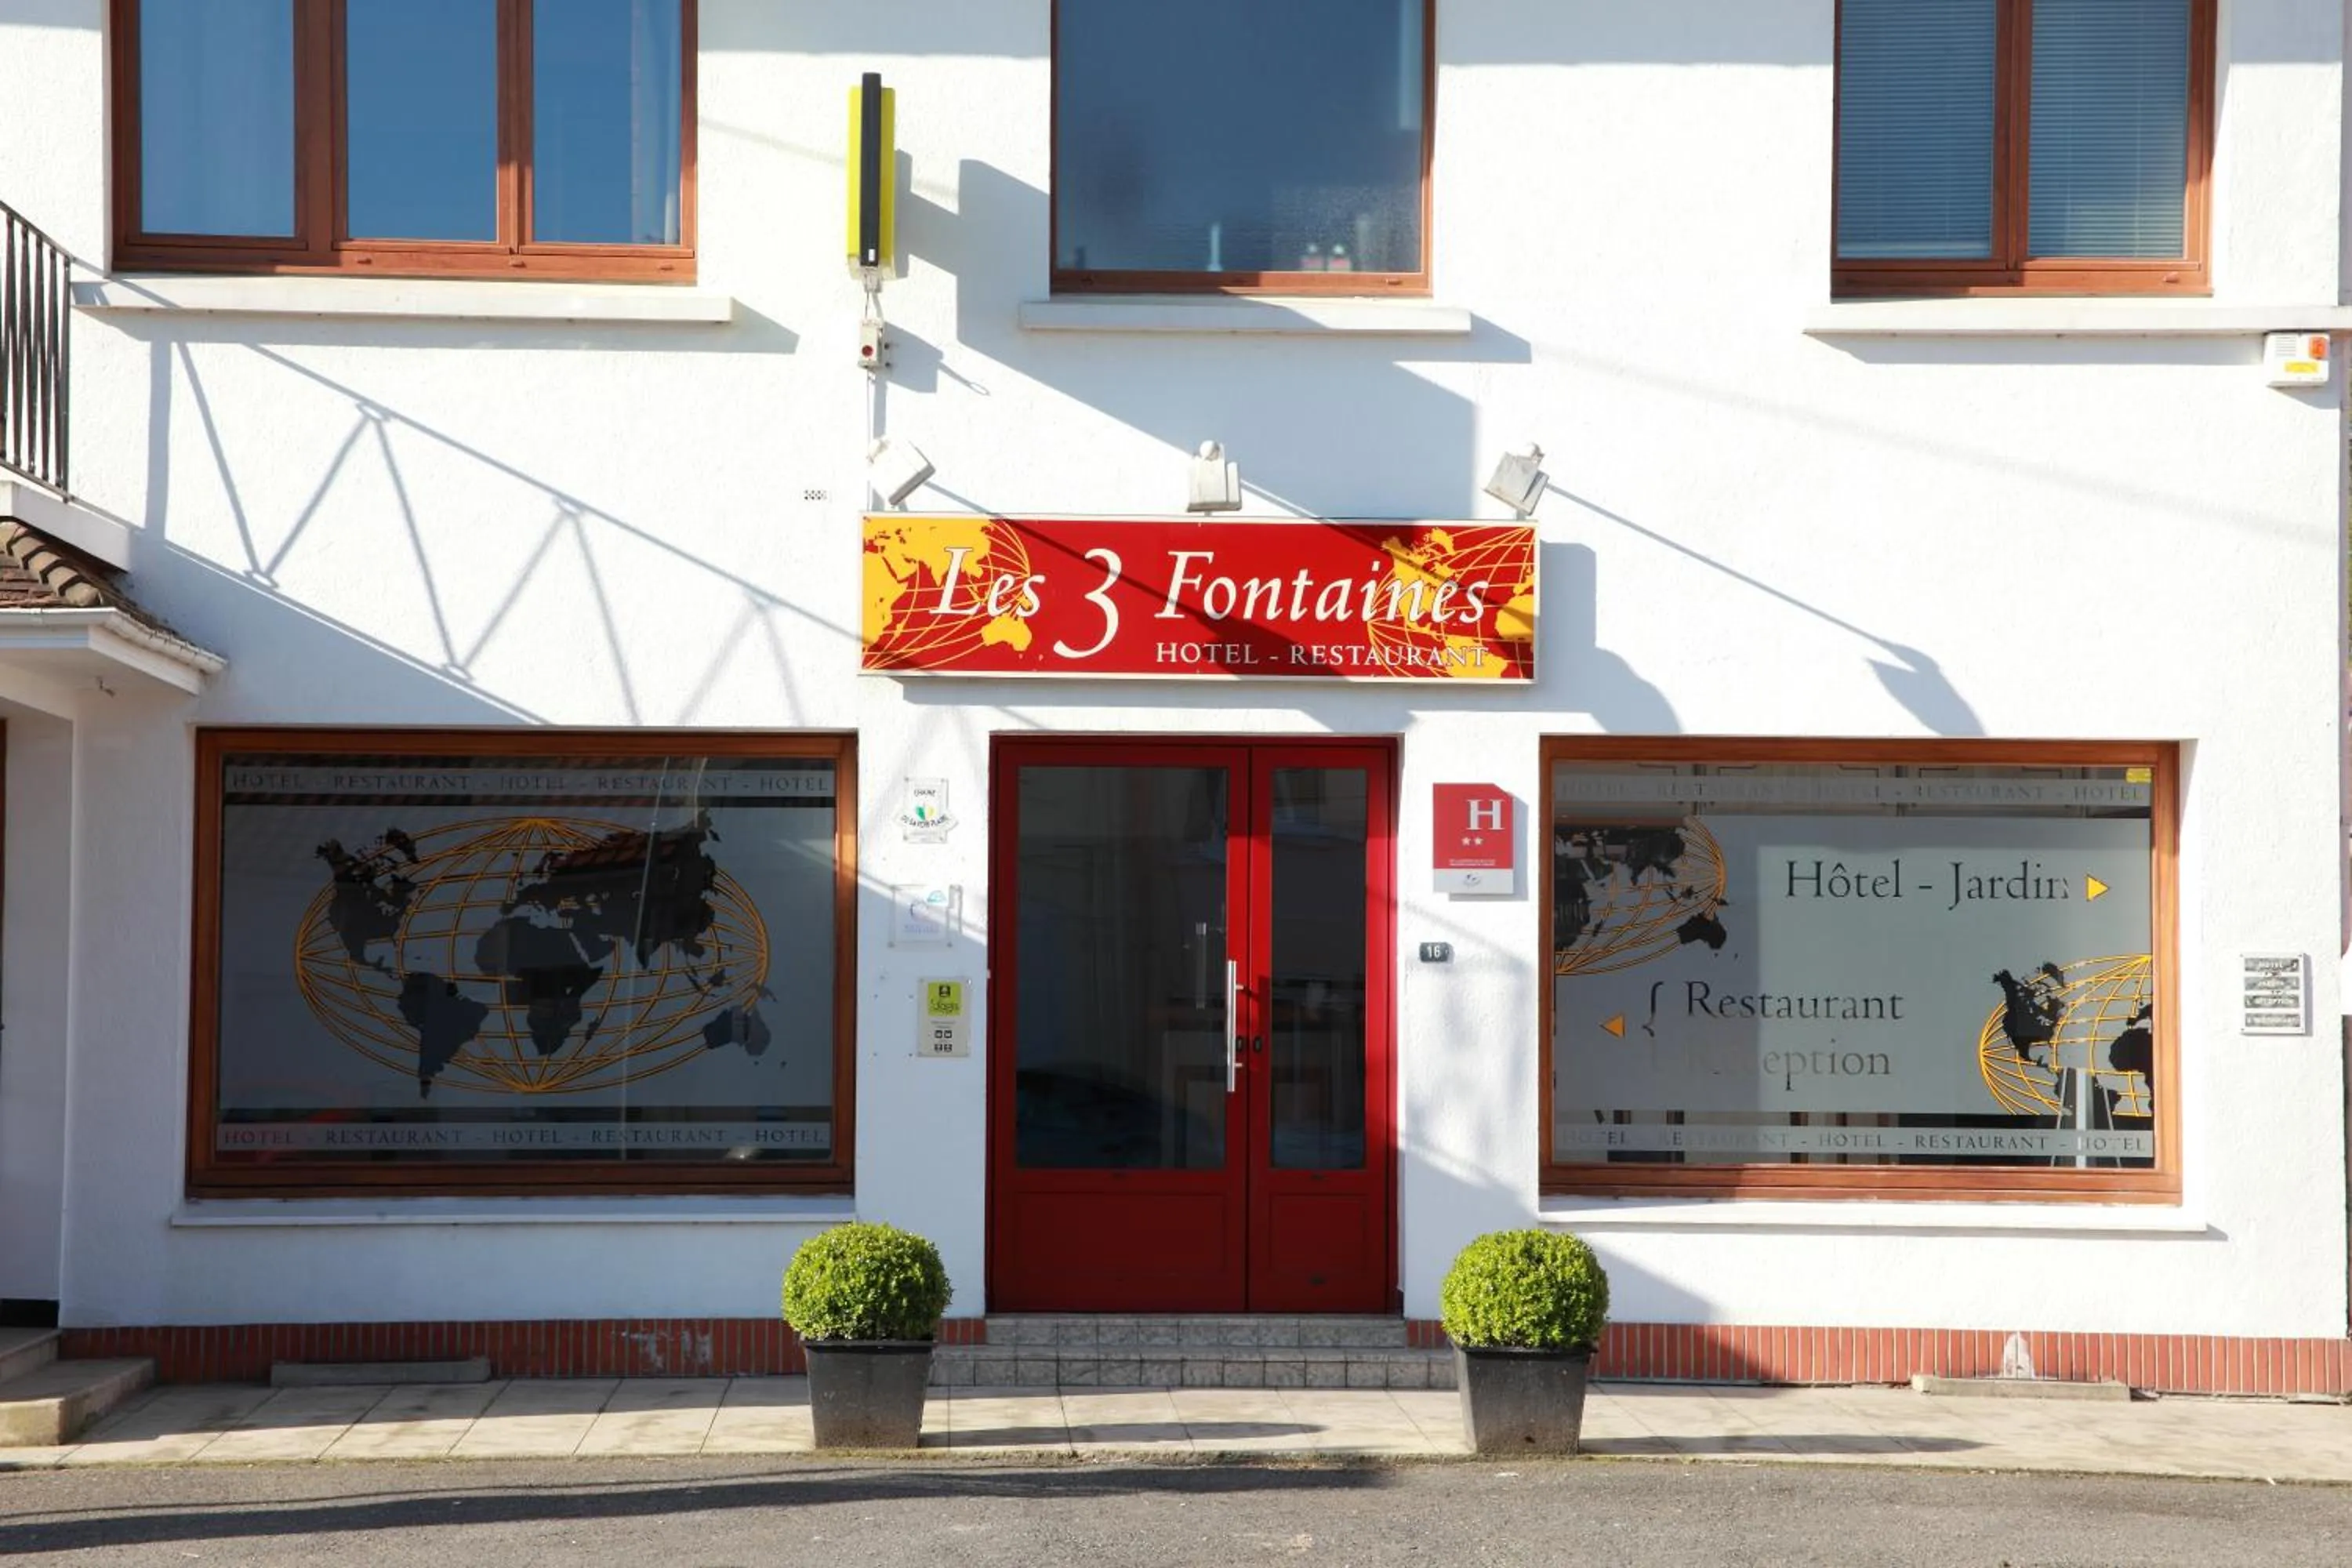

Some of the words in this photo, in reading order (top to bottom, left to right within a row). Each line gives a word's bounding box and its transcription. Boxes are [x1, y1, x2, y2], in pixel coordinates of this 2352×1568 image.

[928, 546, 1046, 617] Les
[1053, 548, 1122, 659] 3
[1154, 550, 1490, 623] Fontaines
[1156, 641, 1259, 665] HOTEL
[1290, 644, 1489, 667] RESTAURANT
[232, 775, 304, 789] HOTEL
[333, 775, 471, 790] RESTAURANT
[597, 777, 731, 791] RESTAURNT
[760, 777, 829, 792] HOTEL
[1466, 798, 1505, 830] H
[1784, 858, 1904, 899] Hôtel
[1948, 859, 2070, 910] Jardin
[1427, 945, 1440, 958] 16
[1683, 980, 1905, 1020] Restaurant
[223, 1131, 294, 1144] HOTEL
[325, 1130, 463, 1144] RESTAURANT
[492, 1130, 563, 1144] HOTEL
[755, 1130, 823, 1143] HOTEL
[1819, 1133, 1886, 1147] HOTEL
[1915, 1134, 2049, 1150] RESTAURANT
